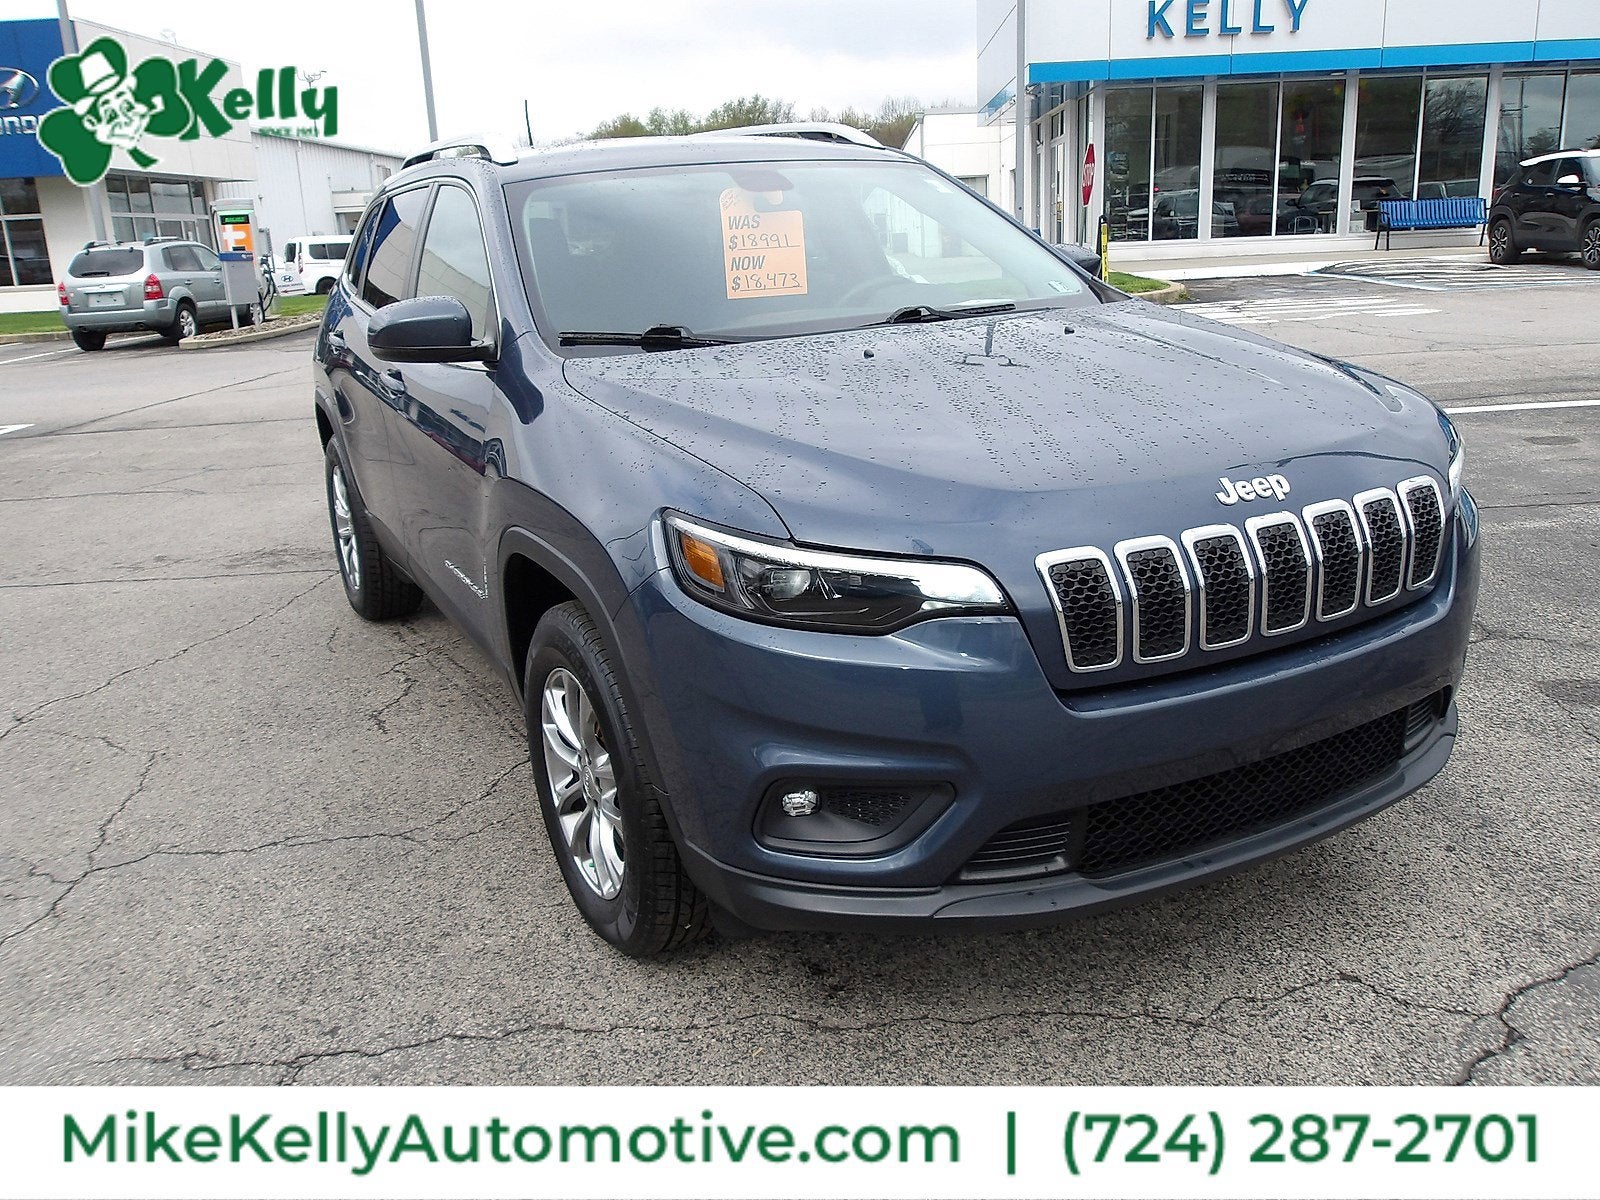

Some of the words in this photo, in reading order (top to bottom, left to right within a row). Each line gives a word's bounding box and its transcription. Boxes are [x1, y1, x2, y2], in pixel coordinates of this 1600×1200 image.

[1146, 0, 1308, 39] KELLY
[728, 214, 761, 230] WAS
[729, 233, 791, 251] $18991
[730, 255, 766, 271] NOW
[731, 272, 801, 292] $18,473
[1215, 473, 1291, 506] Jeep
